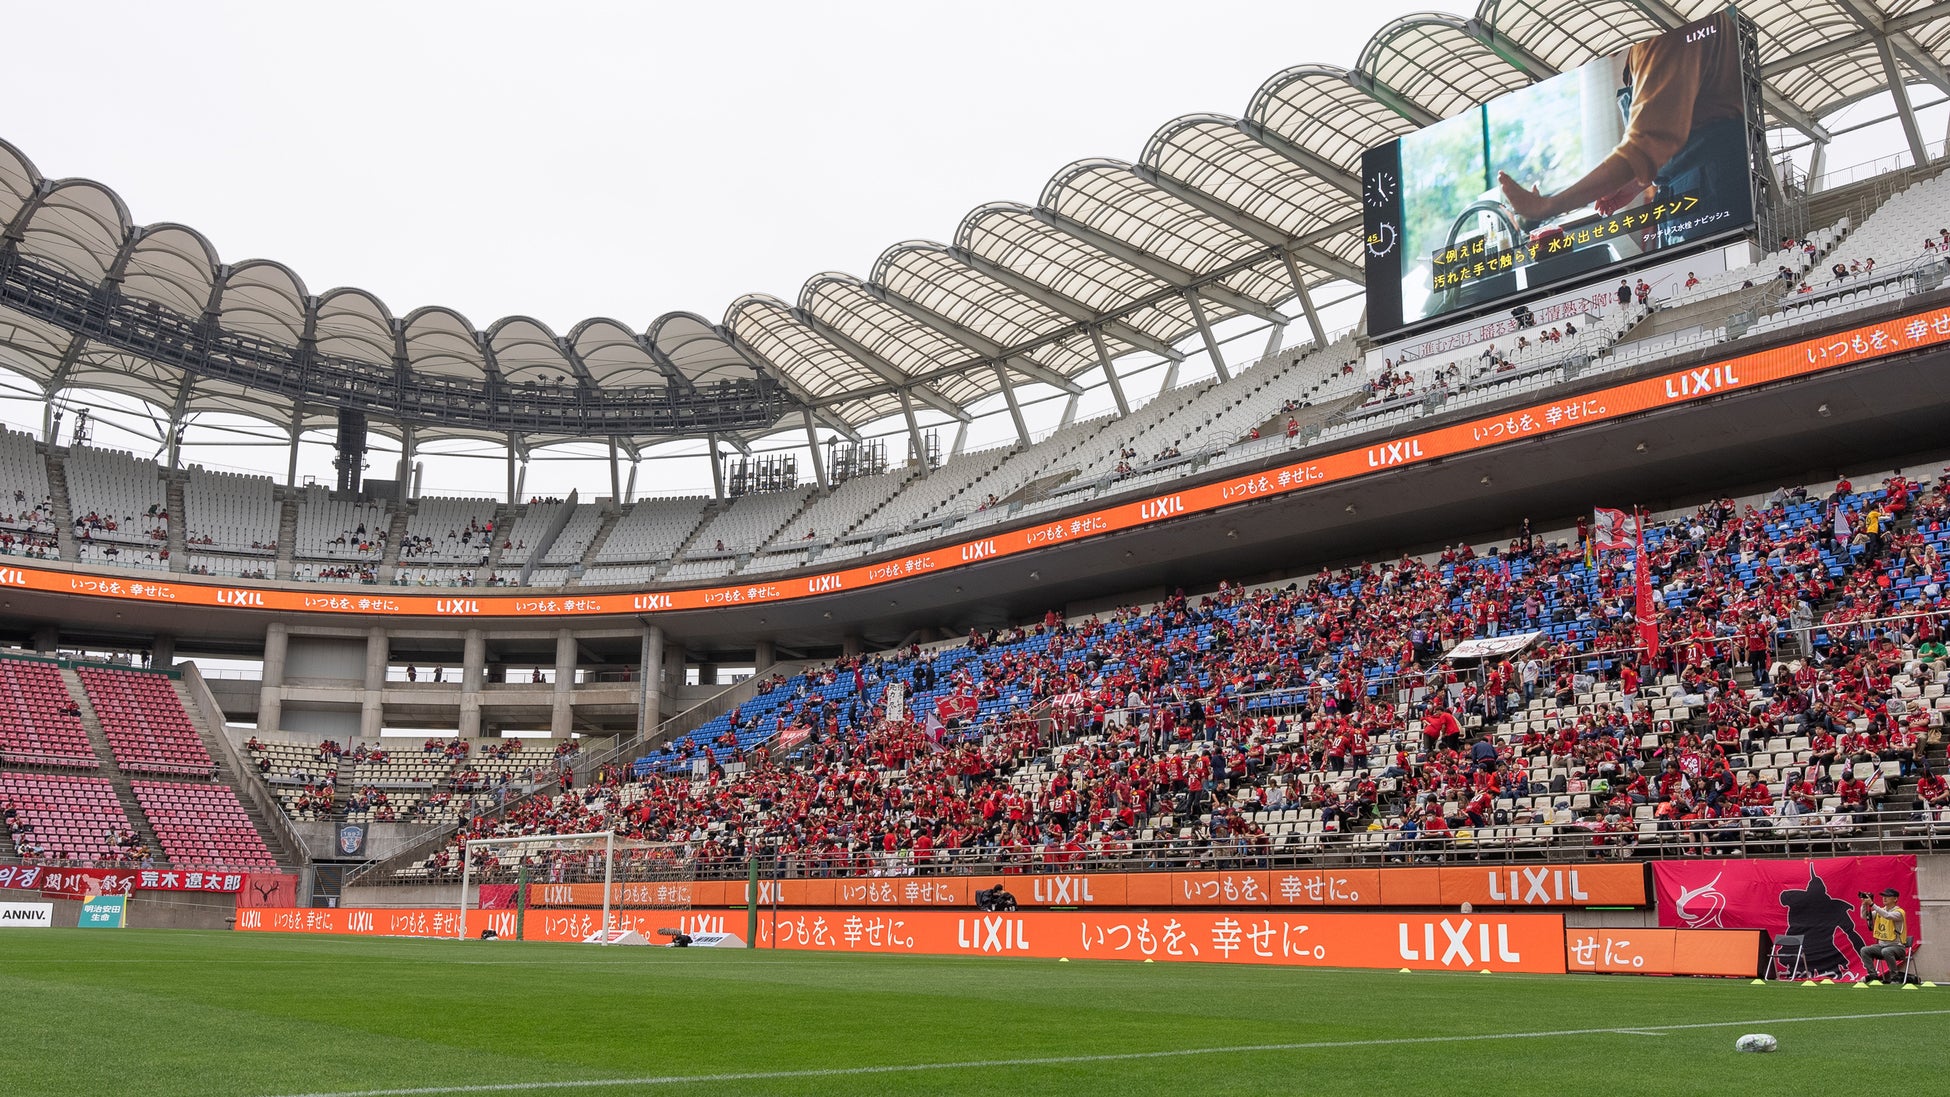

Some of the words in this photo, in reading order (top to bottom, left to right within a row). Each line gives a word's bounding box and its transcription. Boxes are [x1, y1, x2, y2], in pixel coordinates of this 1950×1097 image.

[1686, 25, 1717, 43] LIXIL
[1694, 210, 1730, 229] ナビッシュ
[1367, 233, 1378, 243] 45
[1433, 243, 1540, 290] 汚れた手で触らず
[1665, 364, 1739, 399] LIXIL
[1473, 400, 1606, 441] いつもを、幸せに。
[1368, 440, 1424, 467] LIXIL
[1223, 467, 1324, 499] いつもを、幸せに。
[1142, 495, 1184, 519] LIXIL
[1027, 518, 1107, 545] いつもを、幸せに。
[962, 541, 997, 561] LIXIL
[869, 557, 935, 581] いつもを、幸せに。
[71, 579, 176, 599] いつもを、幸せに。
[705, 586, 780, 603] いつもを、幸せに。
[808, 576, 842, 593] LIXIL
[217, 591, 264, 606] LIXIL
[305, 597, 400, 612] いつもを、幸せに。
[436, 599, 480, 613] LIXIL
[516, 599, 601, 613] いつもを、幸せに。
[634, 595, 673, 610] LIXIL
[1353, 734, 1362, 744] 15
[141, 871, 179, 889] 荒木
[1184, 874, 1359, 903] いつもを、幸せに。
[1488, 865, 1589, 905] LIXIL
[544, 885, 574, 904] LIXIL
[843, 881, 954, 904] いつもを、幸せに。
[1034, 876, 1094, 905] LIXIL
[2, 910, 46, 920] ANNIV.
[84, 904, 121, 914] 明治安田
[91, 913, 111, 922] 生命
[241, 910, 262, 928] LIXIL
[274, 910, 334, 930] いつもを、幸せに。
[348, 911, 374, 932] LIXIL
[958, 915, 1030, 953] LIXIL
[1081, 917, 1326, 961] いつもを、幸せに。
[1398, 917, 1521, 967] LIXIL
[1570, 936, 1645, 968] せに。
